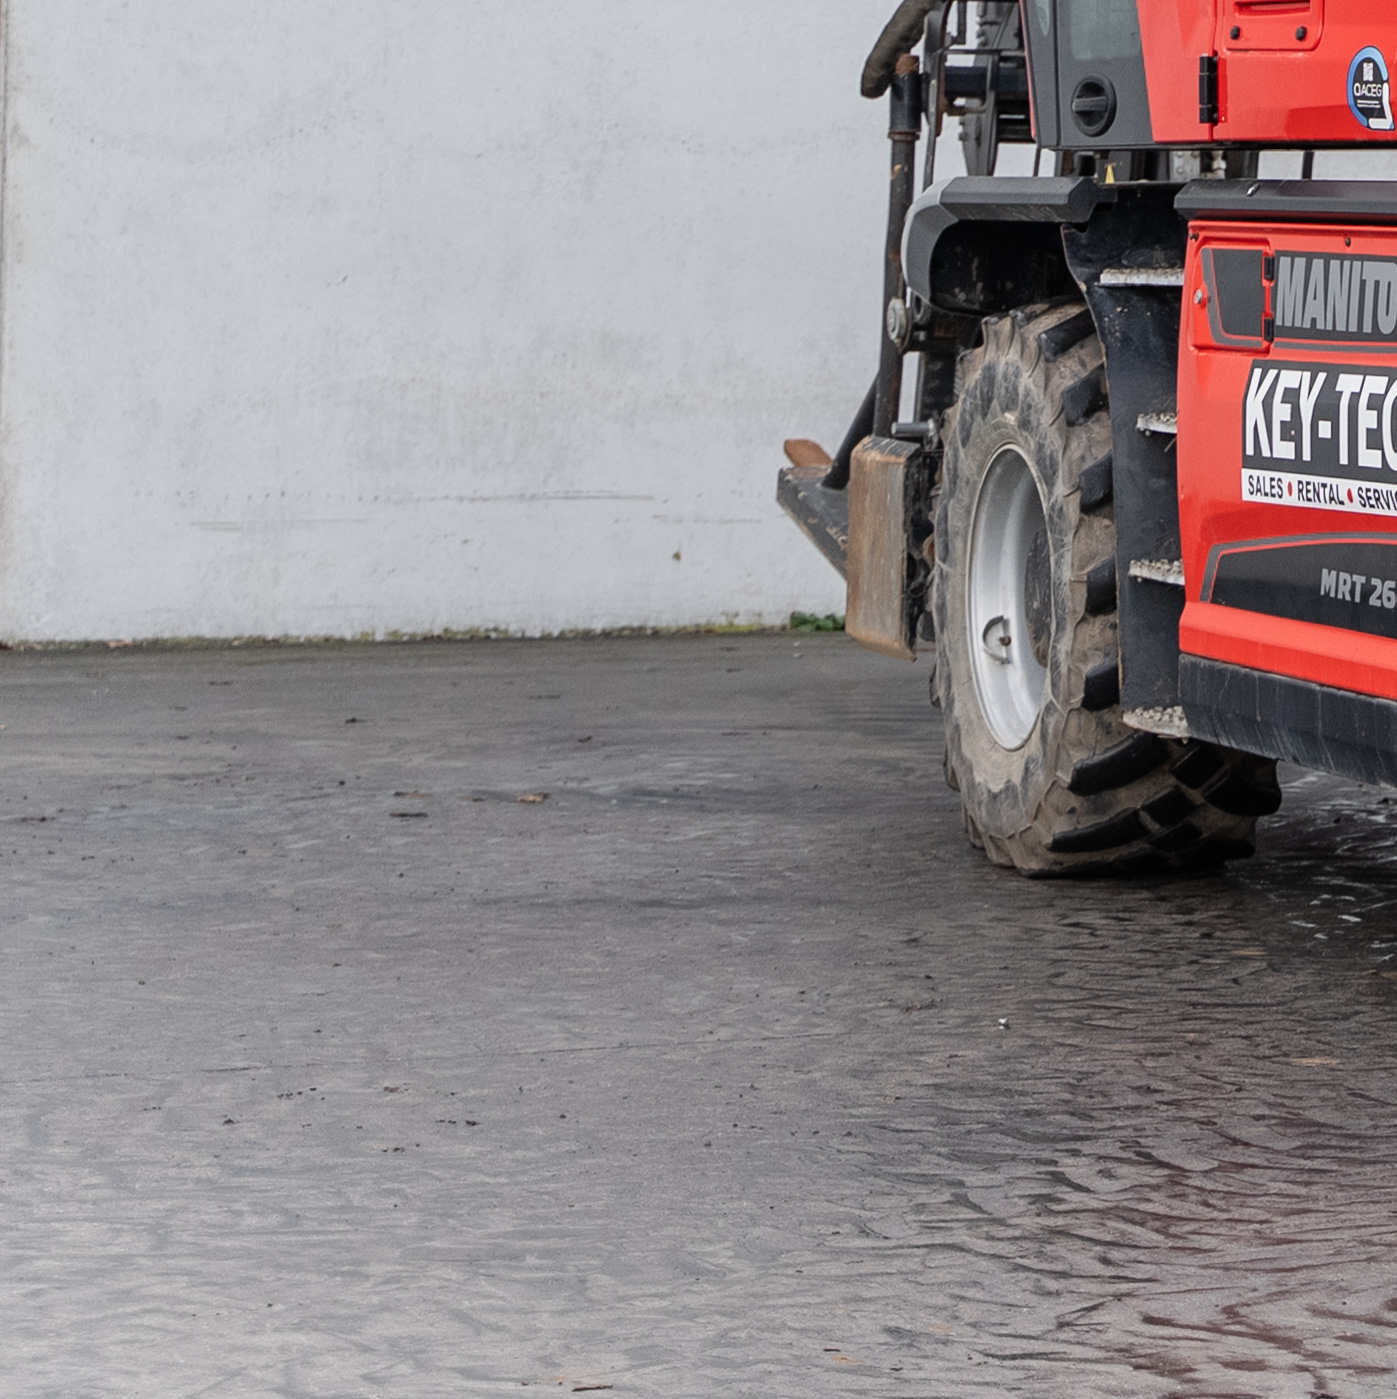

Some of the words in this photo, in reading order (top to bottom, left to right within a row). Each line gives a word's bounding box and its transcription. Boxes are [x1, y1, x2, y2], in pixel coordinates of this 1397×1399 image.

[1247, 474, 1284, 499] SALES
[1297, 480, 1345, 506] RENTAL
[1320, 568, 1366, 603] MRT
